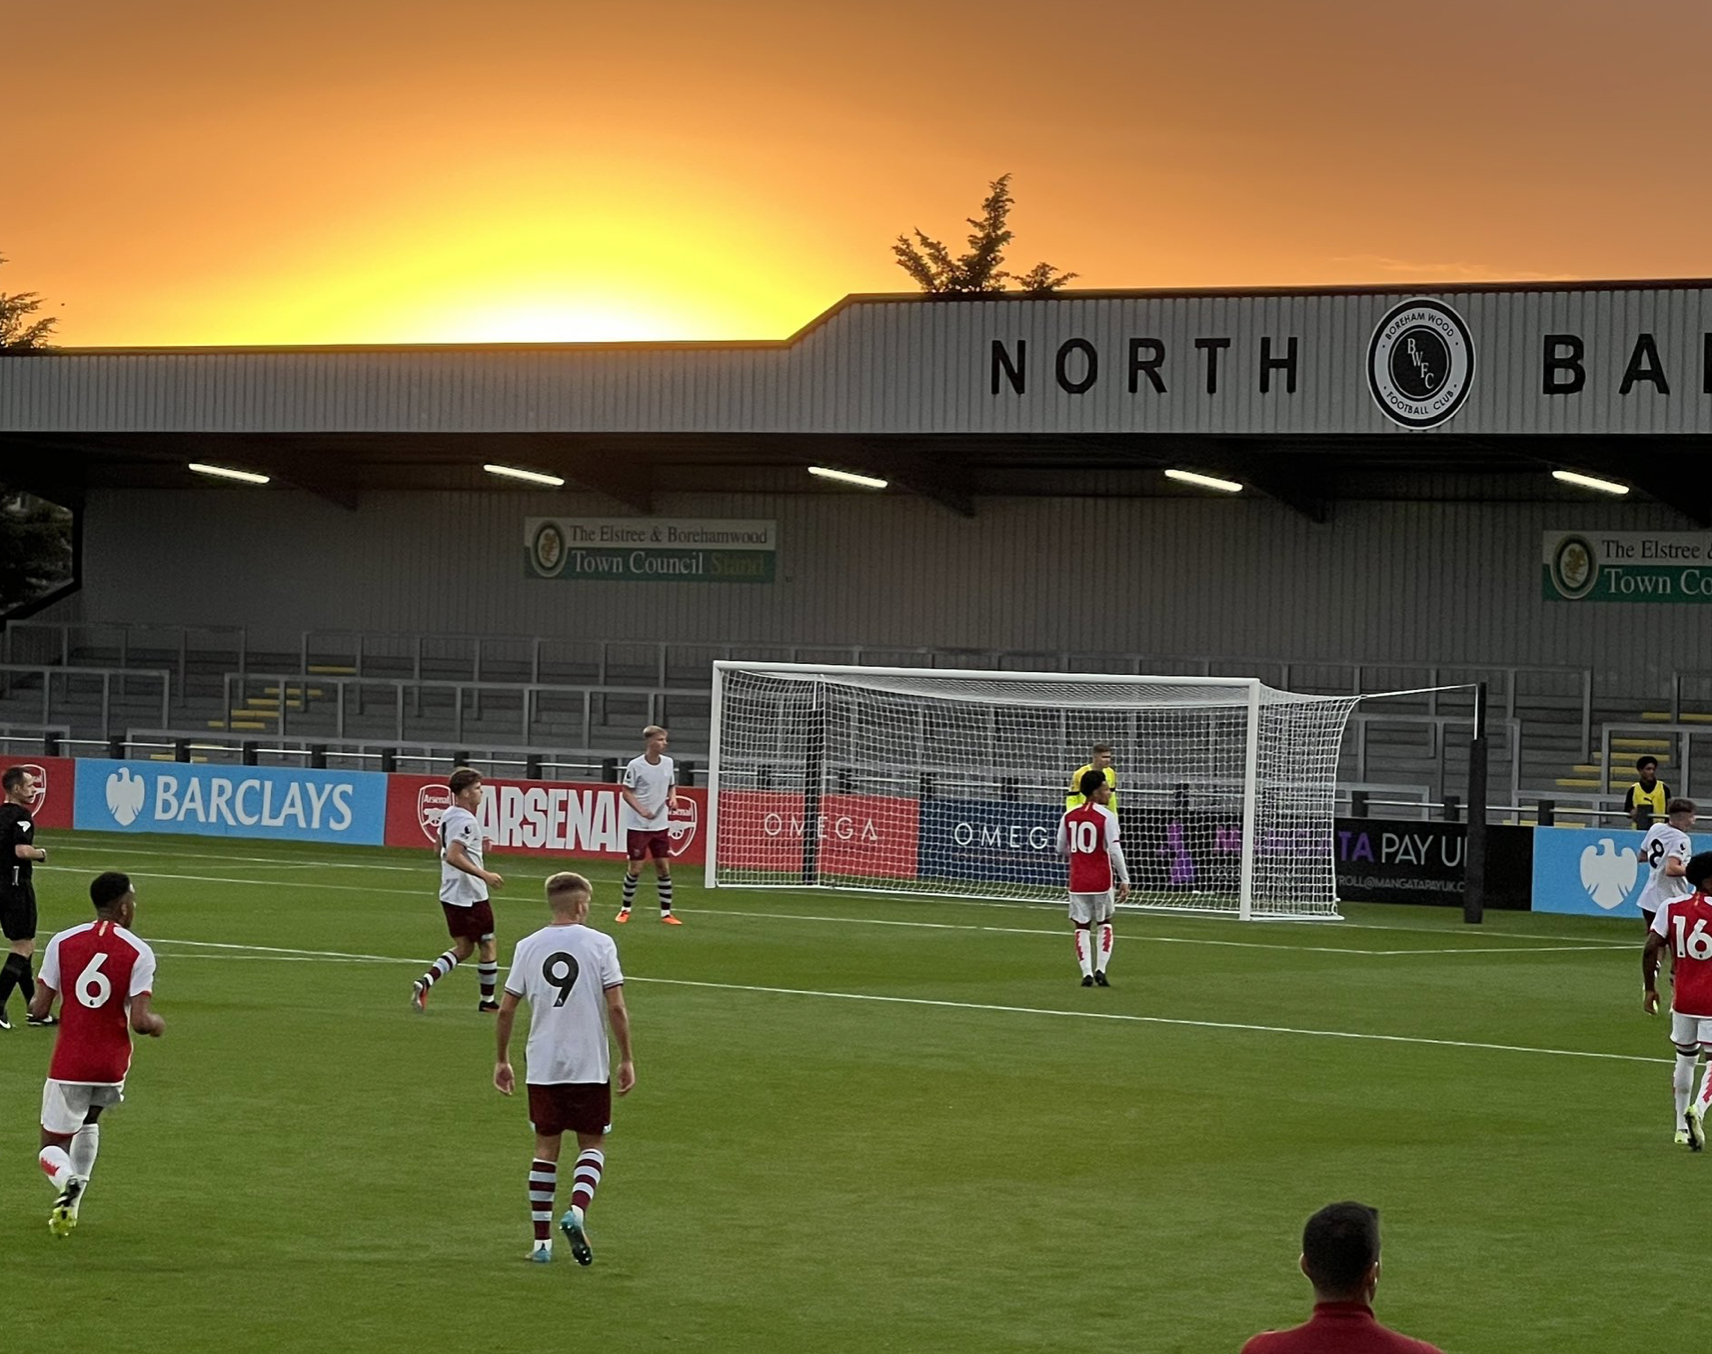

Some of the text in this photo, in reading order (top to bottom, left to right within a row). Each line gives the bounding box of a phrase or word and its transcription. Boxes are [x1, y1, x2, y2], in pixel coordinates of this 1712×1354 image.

[1385, 312, 1454, 340] BOREHAM WOOD
[990, 336, 1298, 395] NORTH
[1407, 338, 1434, 389] BWFC
[1543, 332, 1712, 395] BA
[1386, 390, 1454, 415] FOOTBALL CLUB
[570, 525, 767, 544] The Elstree & Borehamwood
[1602, 540, 1700, 559] The Elstree
[571, 551, 623, 573] Town
[629, 551, 703, 574] Council
[1604, 569, 1712, 595] Town Co
[154, 774, 353, 831] BARCLAYS
[764, 813, 878, 840] OMEGA
[954, 823, 1049, 849] OMEG
[1068, 821, 1098, 854] 10
[1382, 833, 1434, 865] PAY
[1441, 835, 1468, 867] U
[1337, 875, 1466, 893] ROLL@MANGATAPAYUK.C
[1673, 915, 1712, 960] 16
[75, 952, 112, 1008] 6
[542, 951, 579, 1007] 9
